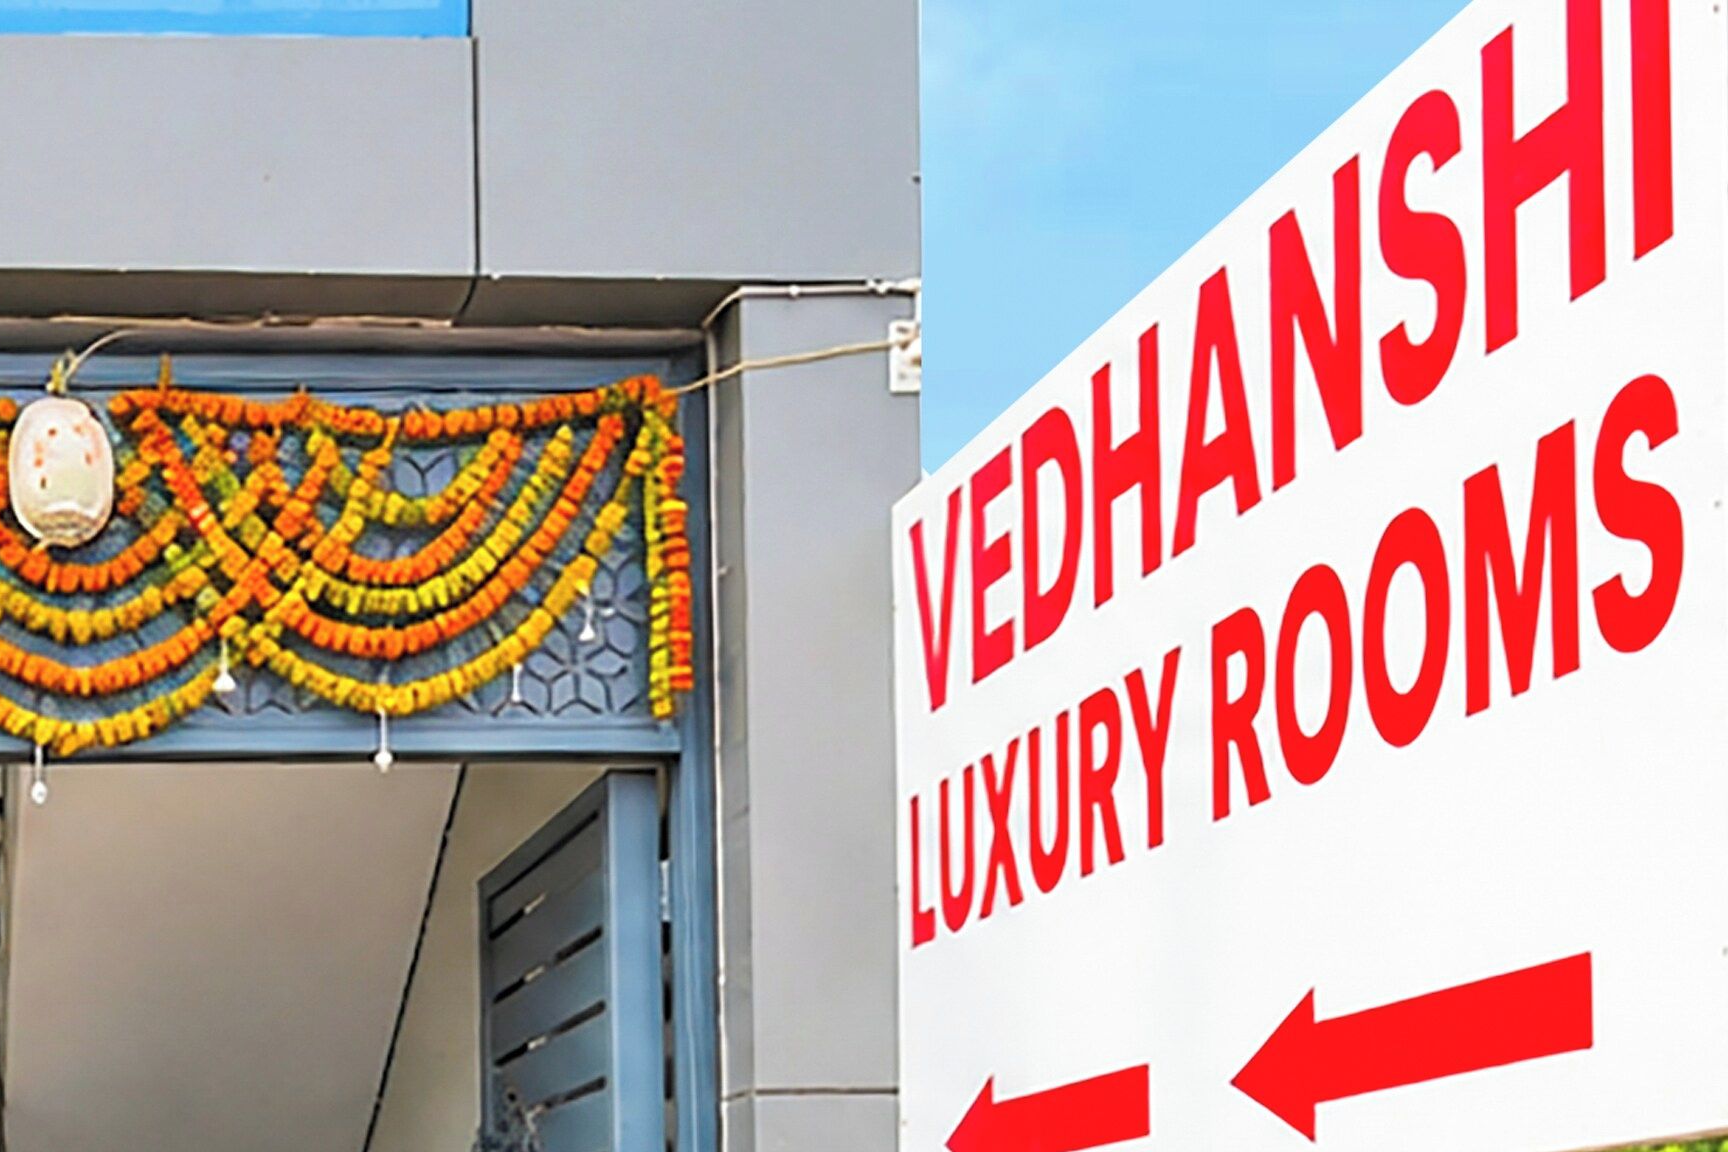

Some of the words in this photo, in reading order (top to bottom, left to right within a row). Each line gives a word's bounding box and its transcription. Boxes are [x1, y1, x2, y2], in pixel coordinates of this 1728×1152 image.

[909, 0, 1674, 711] VEDHANSHI
[910, 646, 1181, 949] LUXURY
[1211, 373, 1684, 822] ROOMS
